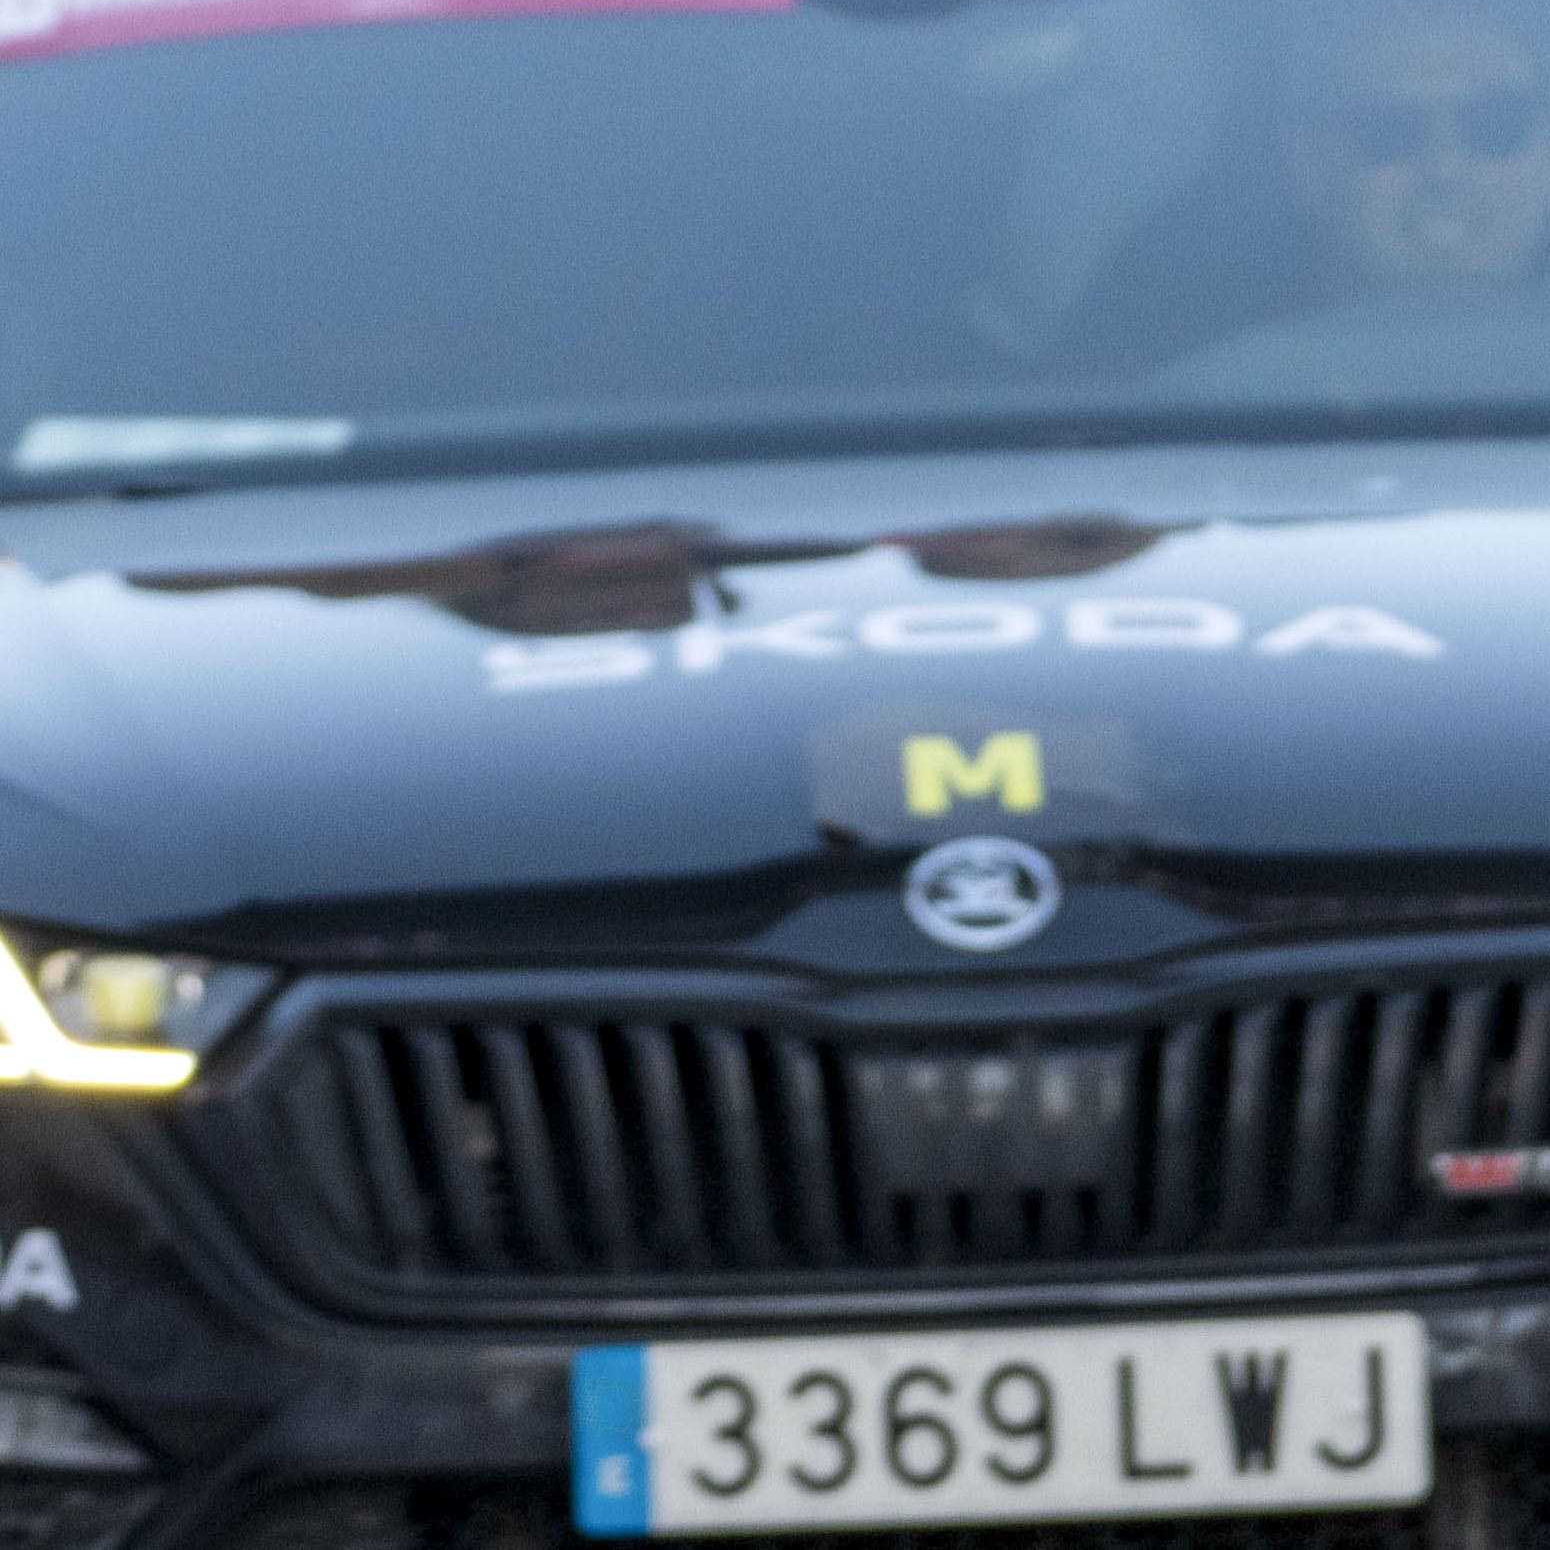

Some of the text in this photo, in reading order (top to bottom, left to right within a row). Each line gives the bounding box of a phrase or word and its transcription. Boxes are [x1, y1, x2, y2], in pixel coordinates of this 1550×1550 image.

[901, 730, 1047, 818] M
[687, 1342, 1390, 1501] 3369 LWJ
